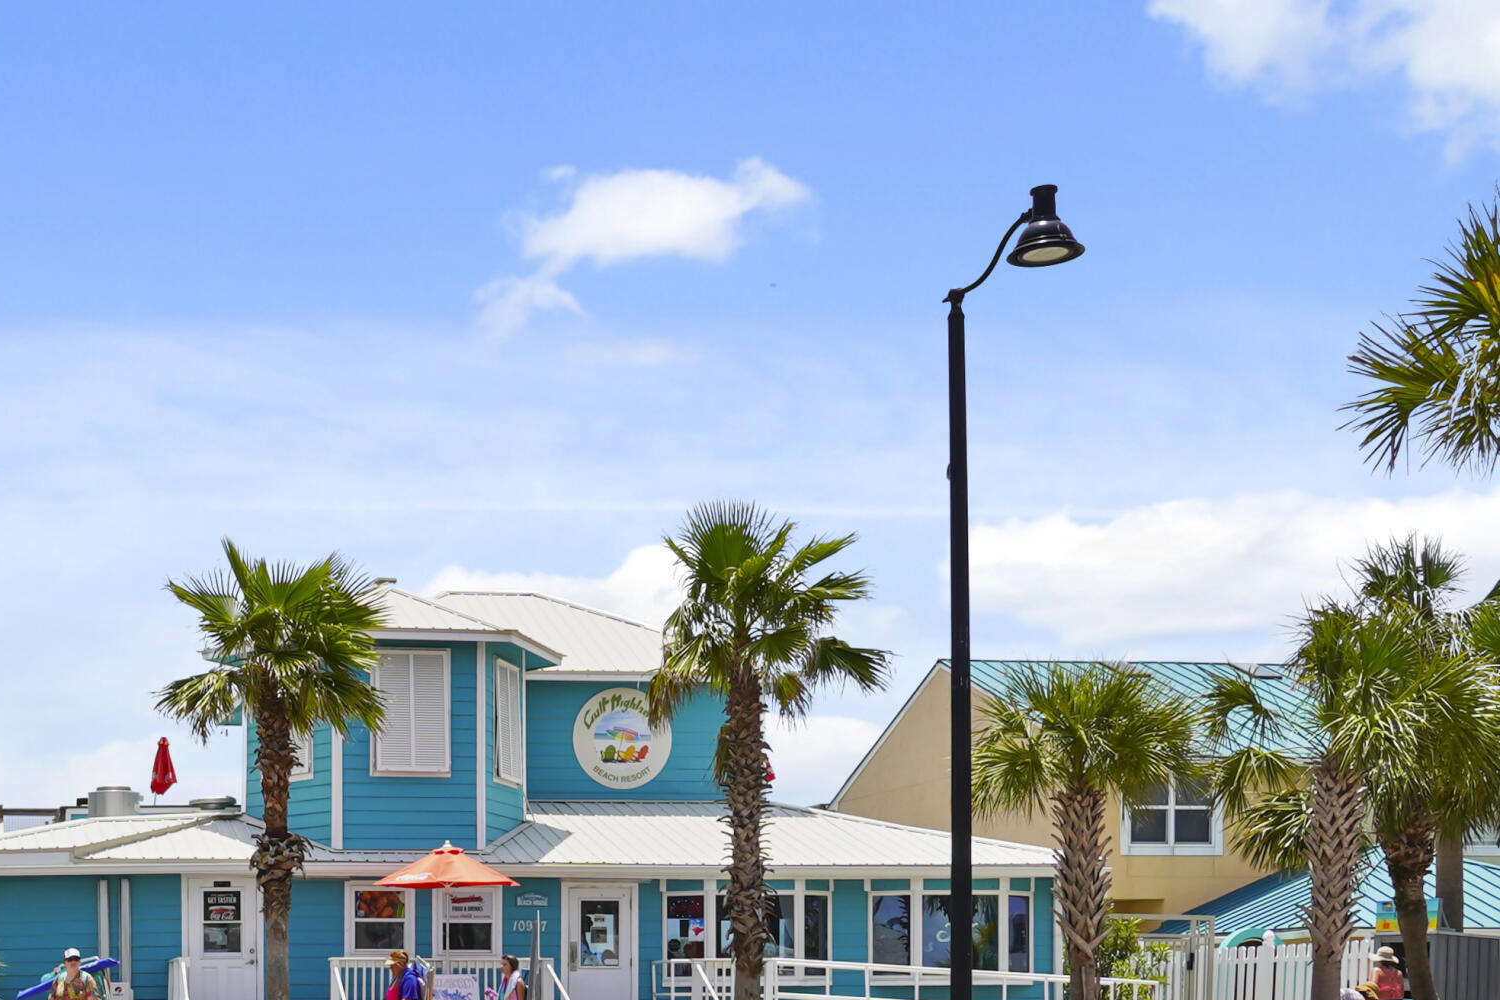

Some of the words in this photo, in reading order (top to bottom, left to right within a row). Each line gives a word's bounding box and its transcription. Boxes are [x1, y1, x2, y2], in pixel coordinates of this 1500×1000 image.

[583, 697, 609, 729] Gulf
[610, 693, 651, 718] Highlan
[592, 765, 619, 783] BEACH
[620, 766, 652, 783] RESORT
[512, 920, 547, 932] 1097
